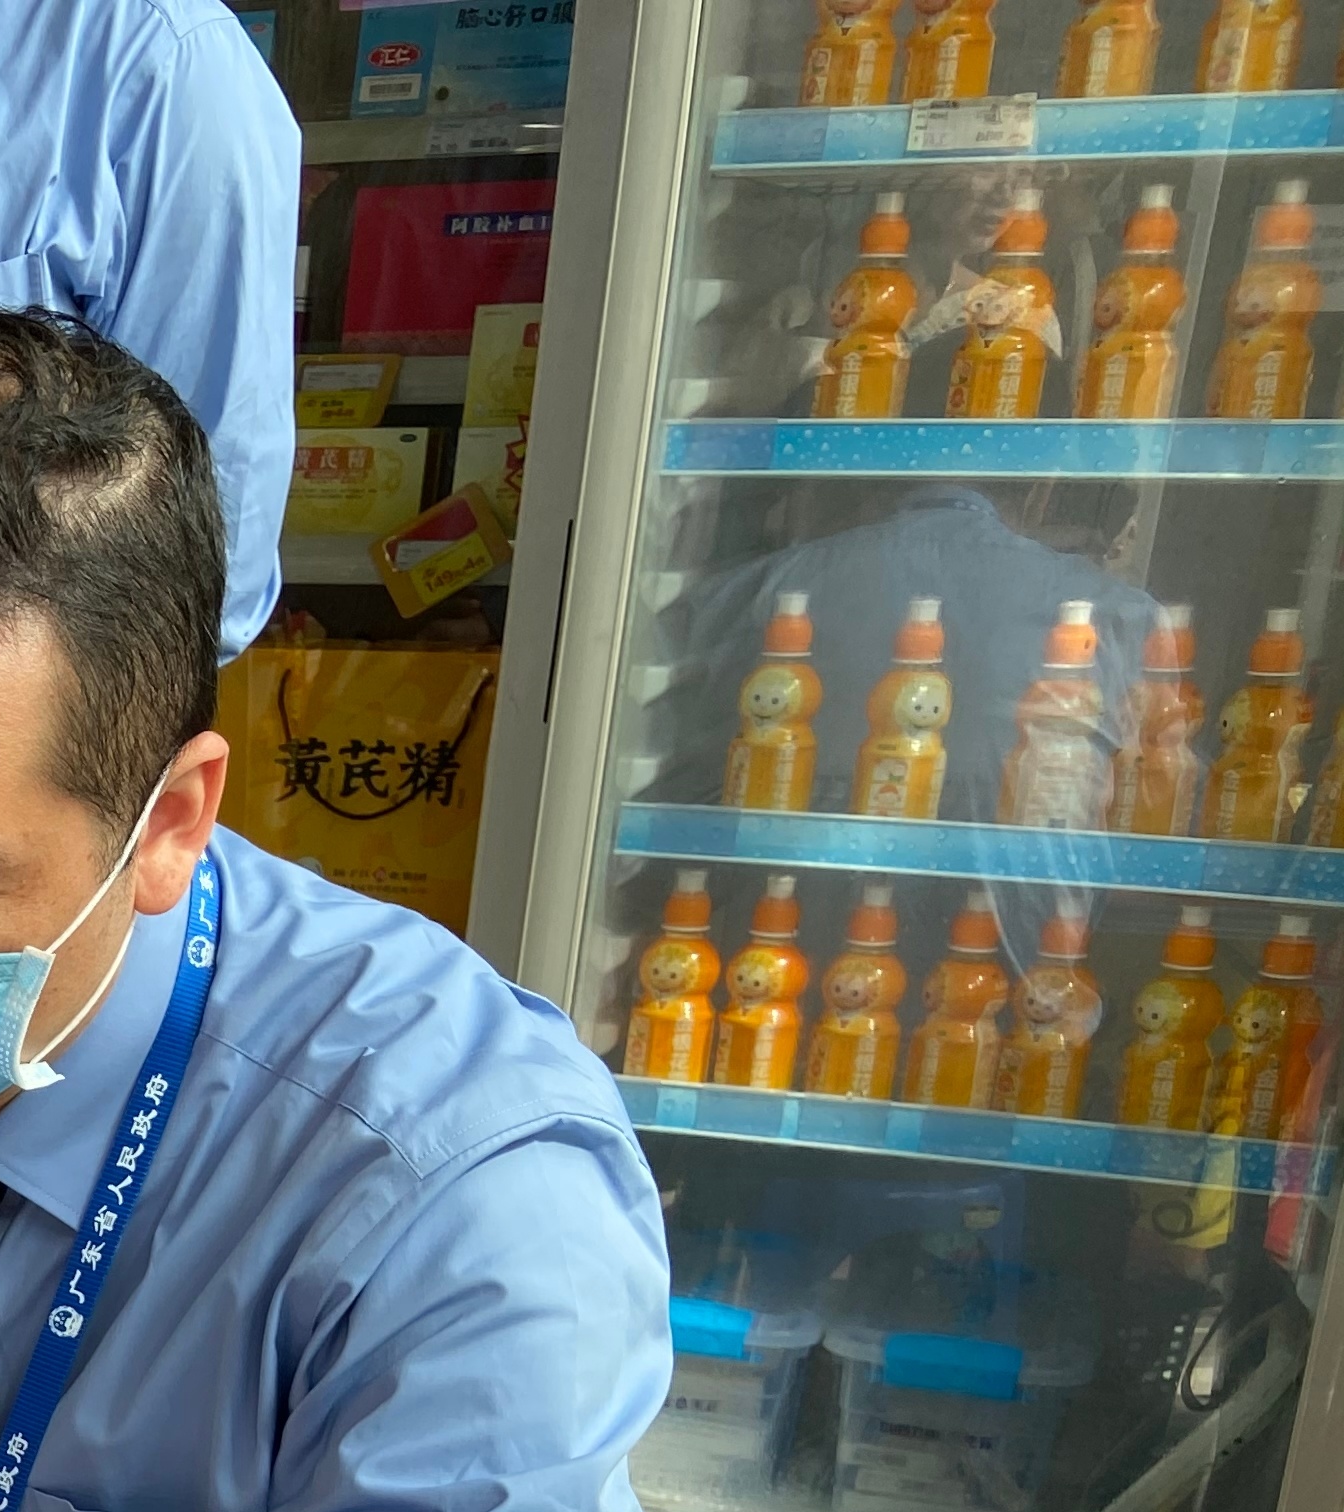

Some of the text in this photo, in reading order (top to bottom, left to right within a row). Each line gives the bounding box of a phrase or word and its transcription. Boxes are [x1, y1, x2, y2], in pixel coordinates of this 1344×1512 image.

[67, 1073, 172, 1305] 广东省人民政府
